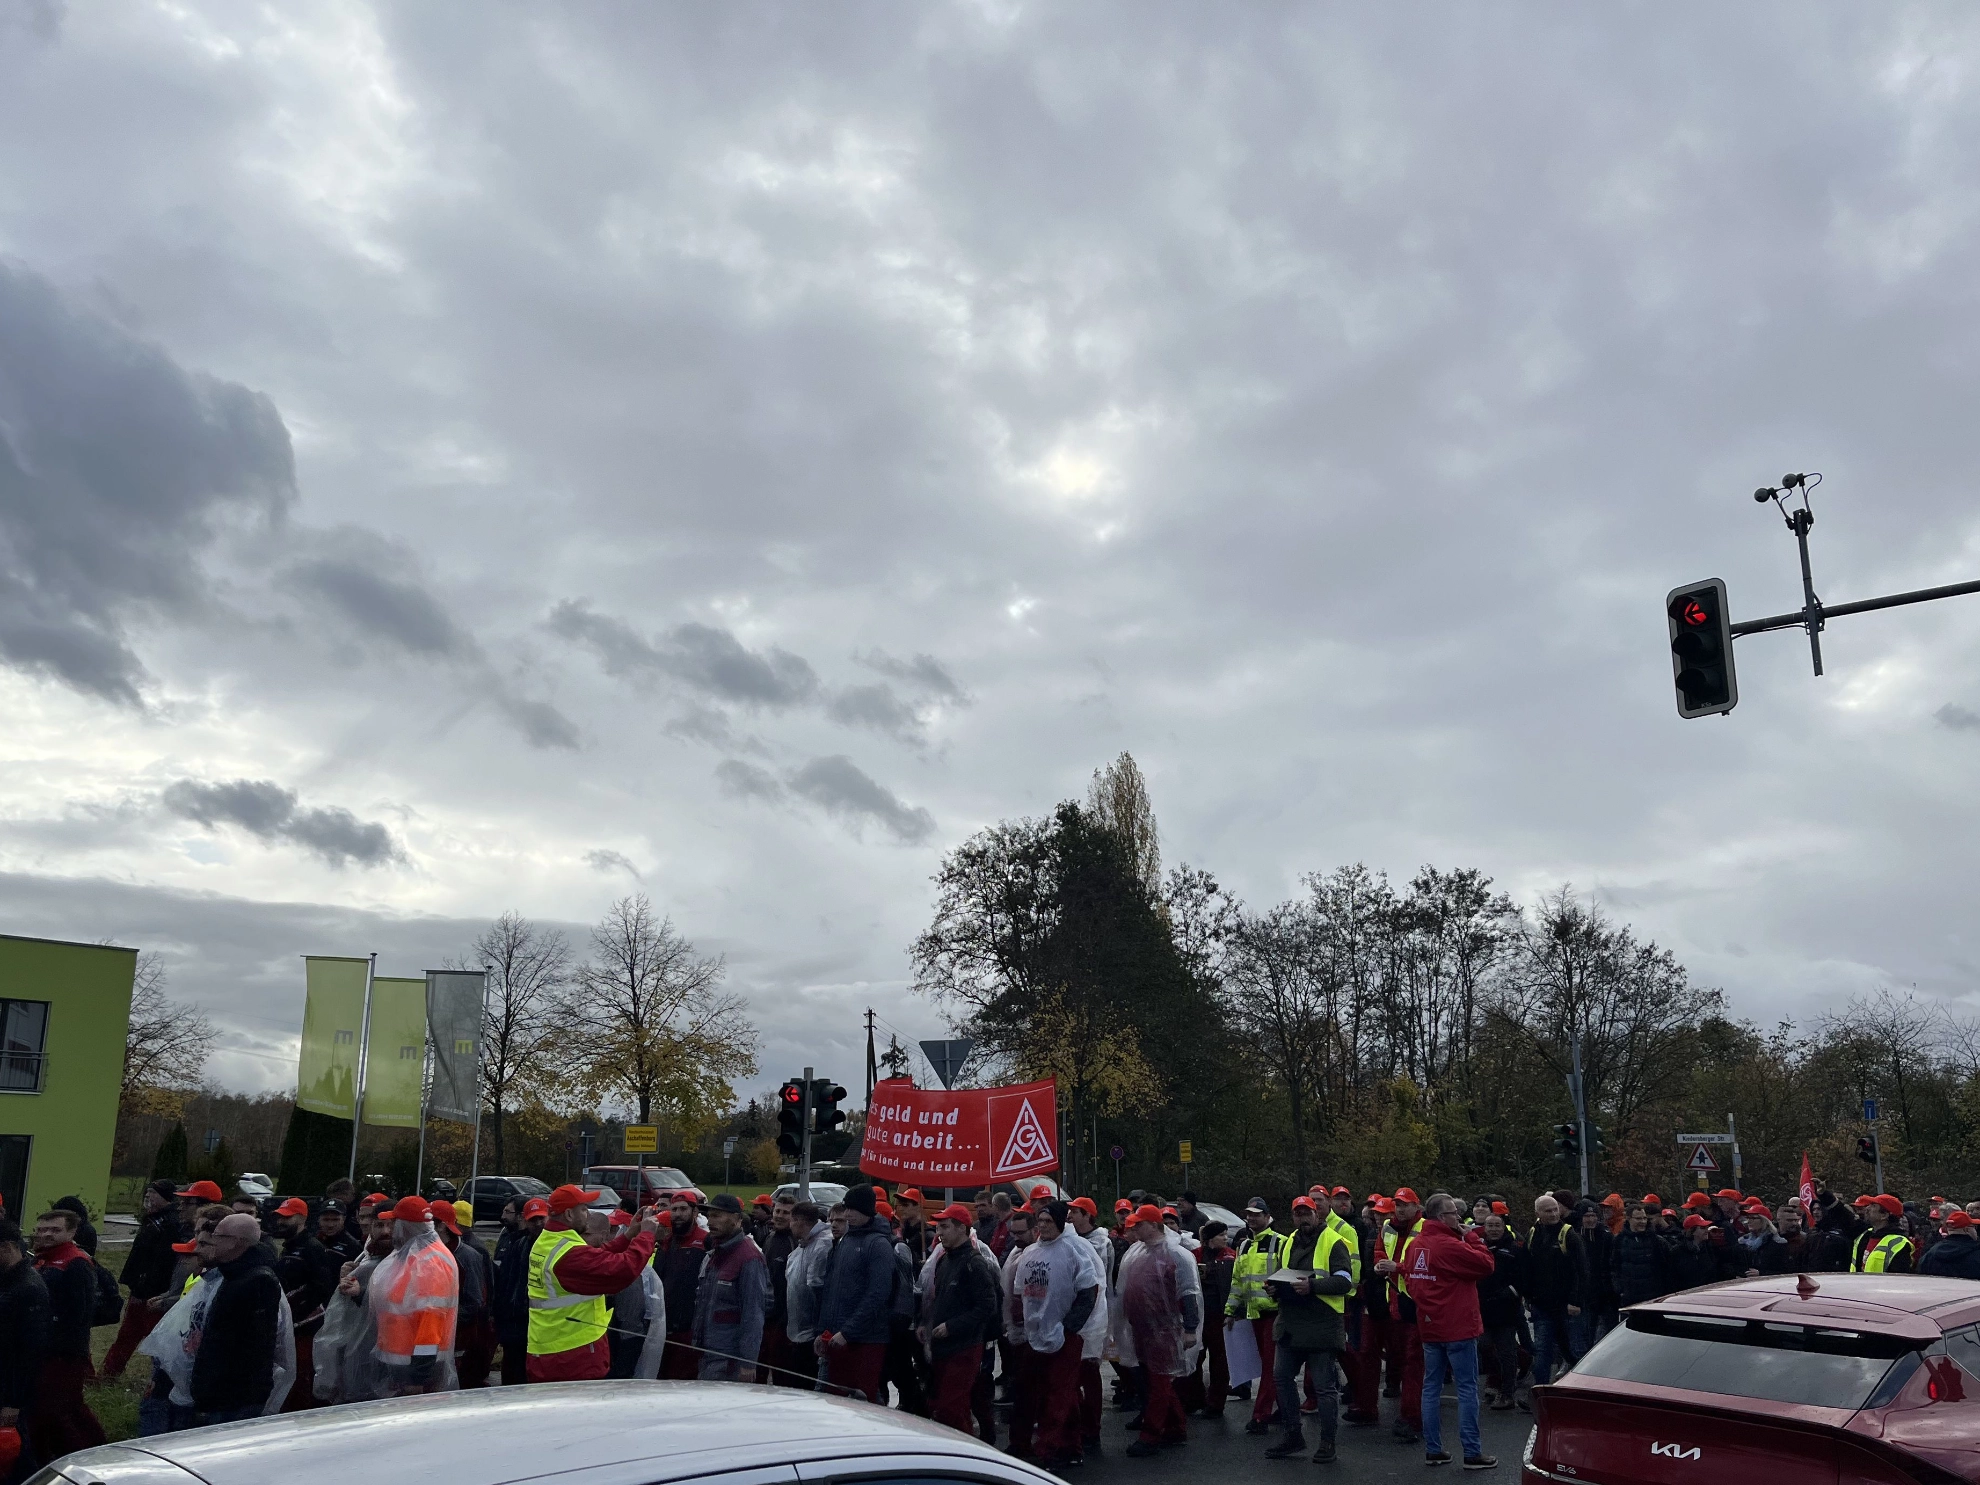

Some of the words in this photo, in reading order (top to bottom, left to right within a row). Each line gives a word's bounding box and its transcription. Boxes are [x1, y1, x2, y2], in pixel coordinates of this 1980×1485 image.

[880, 1105, 911, 1123] geld
[918, 1108, 959, 1125] und
[867, 1125, 888, 1143] gute
[903, 1161, 925, 1171] und
[930, 1161, 974, 1172] leute!
[1652, 1441, 1701, 1460] KIA
[1556, 1464, 1577, 1475] EV6
